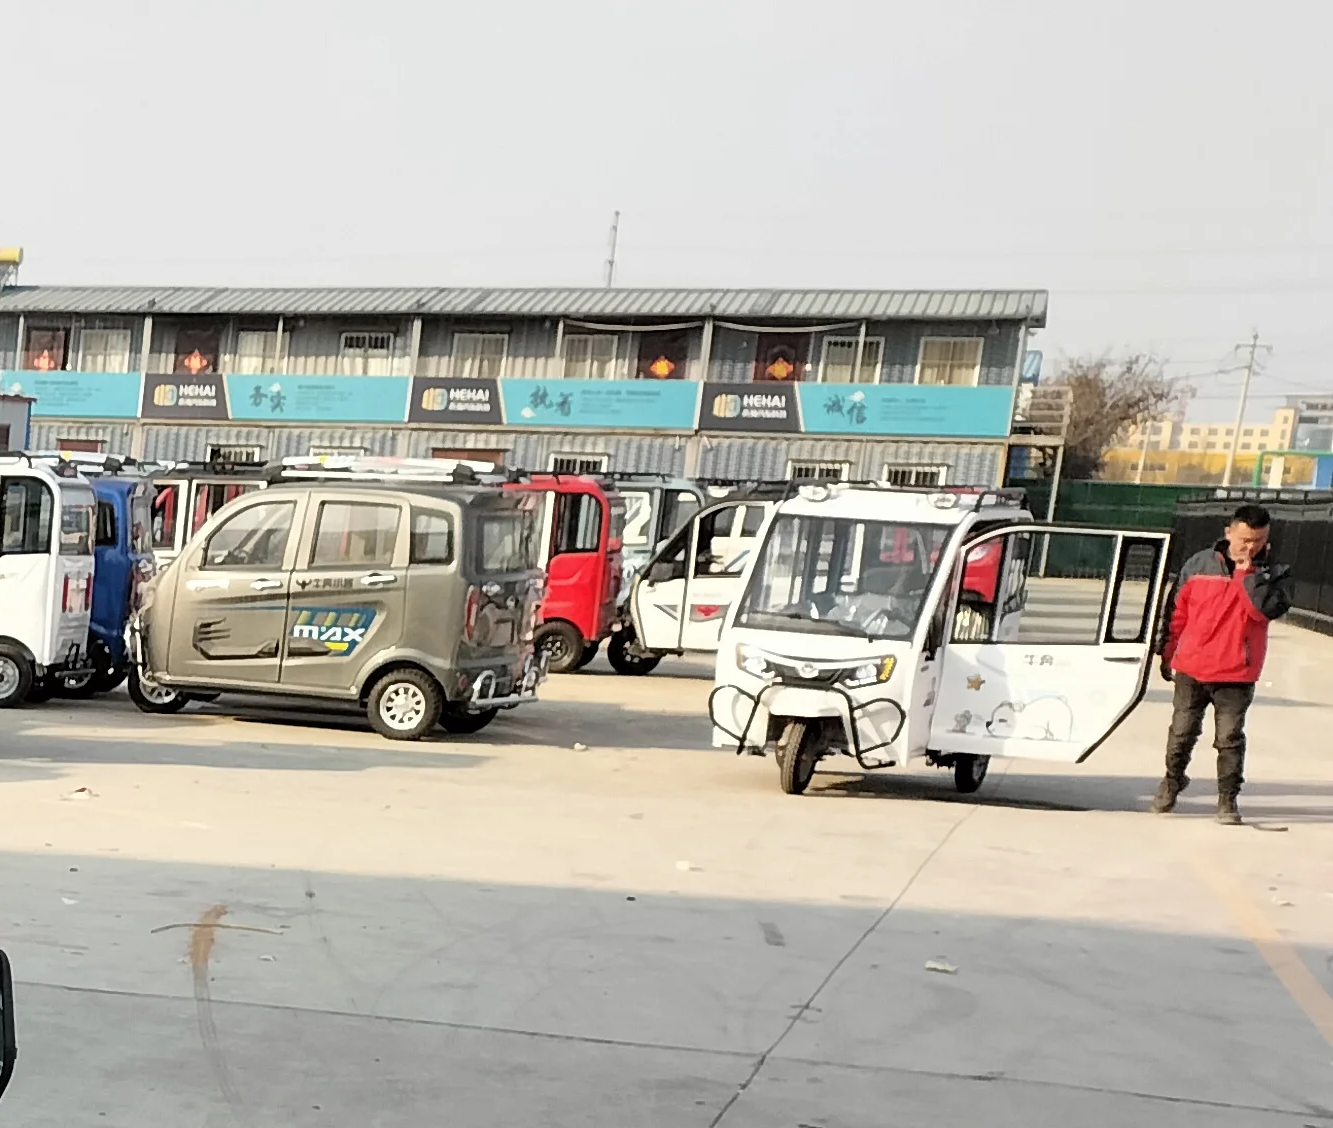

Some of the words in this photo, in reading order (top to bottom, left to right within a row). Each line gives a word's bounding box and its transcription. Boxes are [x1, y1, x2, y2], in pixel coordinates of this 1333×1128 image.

[178, 384, 216, 397] HEHAI
[449, 387, 491, 401] HEHAI
[742, 394, 786, 408] HEHAI
[824, 395, 867, 425] 诚信
